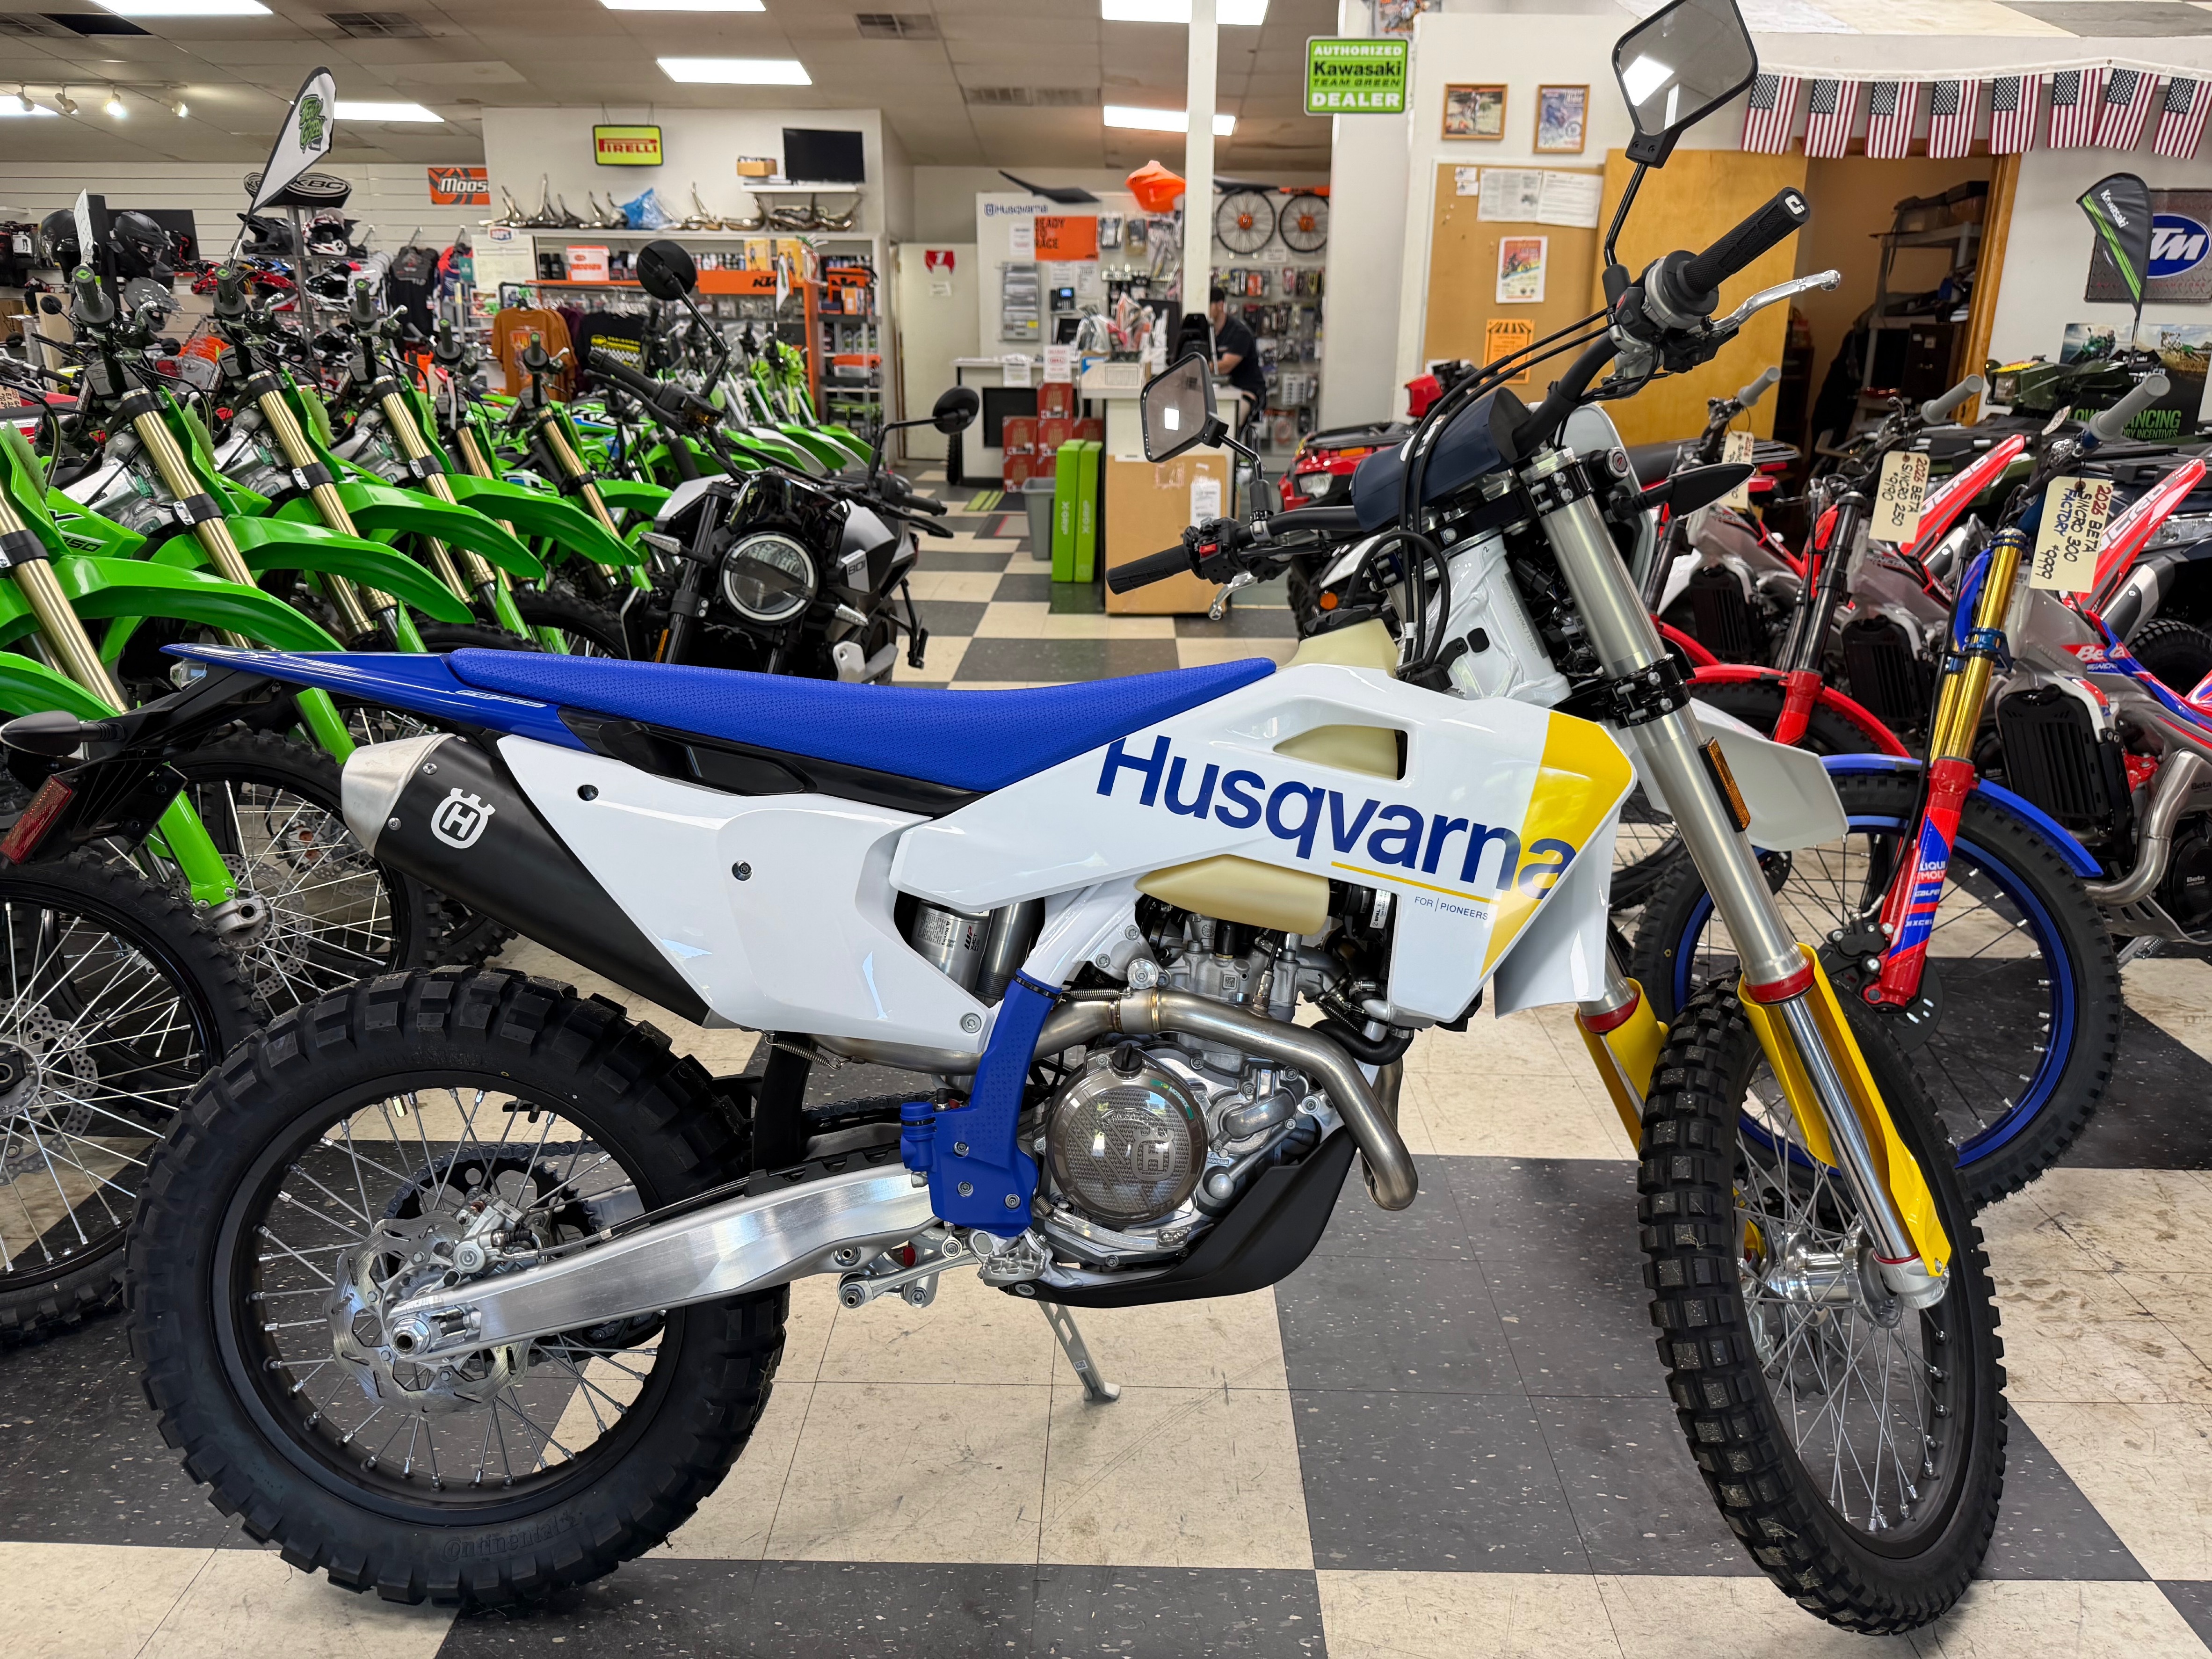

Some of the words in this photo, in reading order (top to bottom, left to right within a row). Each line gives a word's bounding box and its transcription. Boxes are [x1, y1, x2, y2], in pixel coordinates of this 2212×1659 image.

[1314, 45, 1402, 56] AUTHORIZED
[1314, 61, 1400, 76] Kawasaki
[1312, 92, 1400, 107] DEALER
[599, 138, 657, 153] PIRELLI
[292, 180, 344, 189] KBC
[440, 177, 489, 193] Moos
[2100, 189, 2129, 229] Kawasaki
[2136, 429, 2178, 439] INCENTIVES
[1897, 463, 1913, 500] SINCRO
[1914, 457, 1928, 483] 2026
[1907, 485, 1922, 513] BETA
[2091, 485, 2111, 517] 2026
[1892, 502, 1906, 526] 250
[2053, 488, 2079, 537] FACTORY
[2070, 491, 2092, 533] SINCRO
[64, 537, 102, 553] 50
[2082, 520, 2103, 553] BETA
[2063, 536, 2081, 562] 300
[2035, 544, 2060, 580] $9999
[1096, 735, 1577, 900] Husqvarna
[1920, 861, 1946, 871] LIQUI
[1414, 896, 1433, 907] FOR
[1440, 902, 1488, 920] PIONEERS
[942, 927, 950, 946] Warning
[964, 924, 973, 950] WP
[1168, 1086, 1189, 1108] MOTOREX
